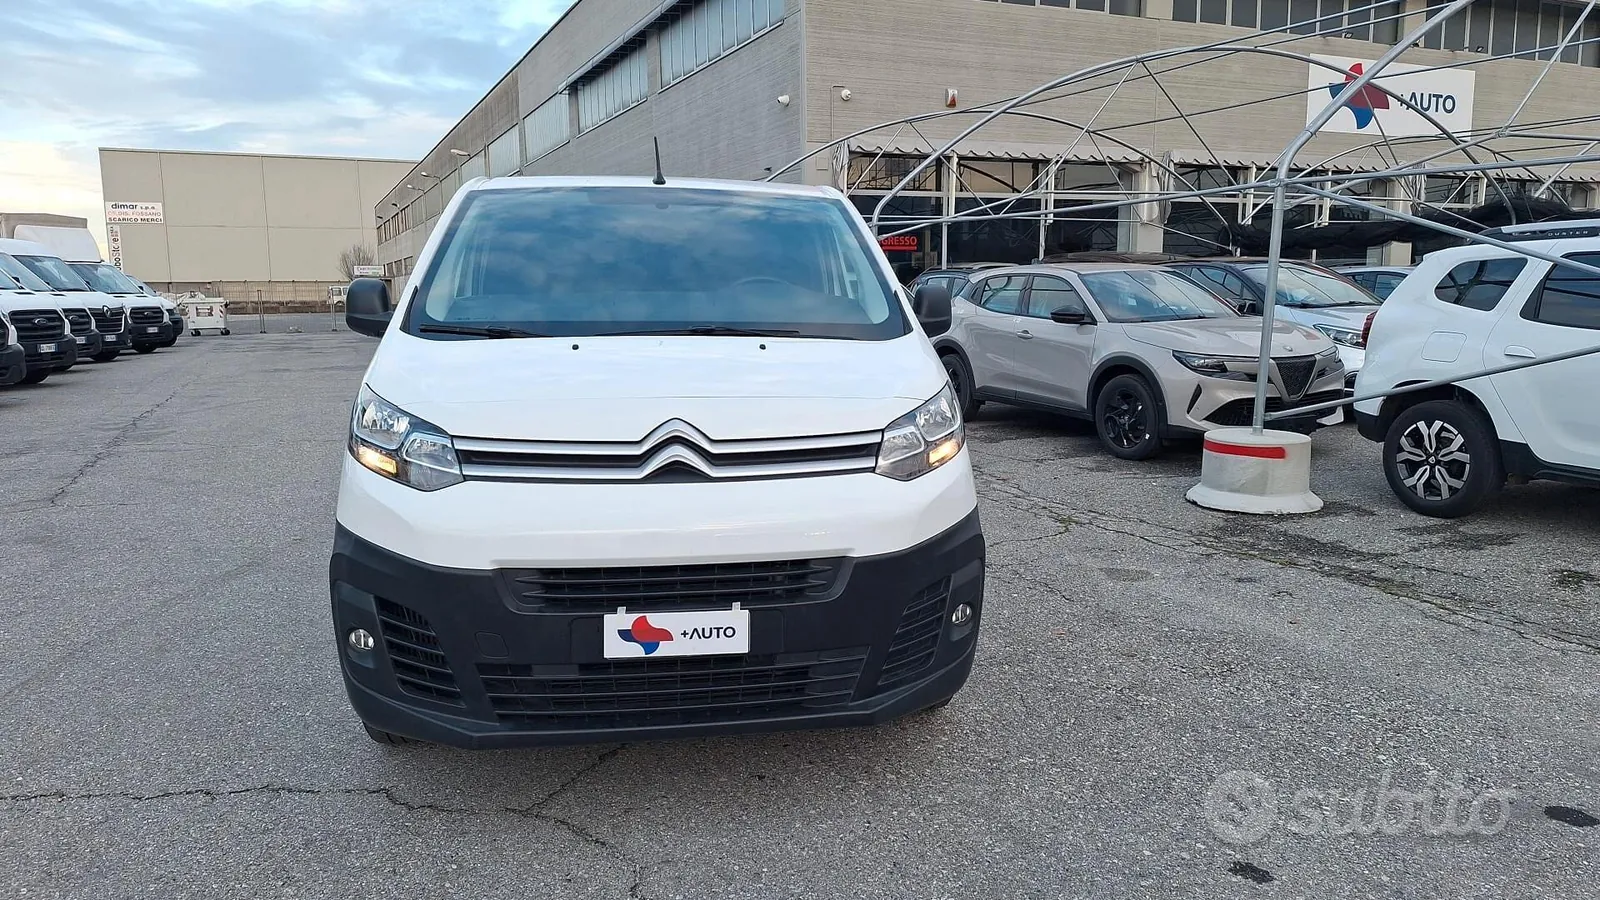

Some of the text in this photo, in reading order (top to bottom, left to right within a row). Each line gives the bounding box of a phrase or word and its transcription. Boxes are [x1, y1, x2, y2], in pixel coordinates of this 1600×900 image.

[111, 202, 138, 210] dimar
[880, 236, 918, 245] GRESSO
[680, 626, 736, 640] +AUTO
